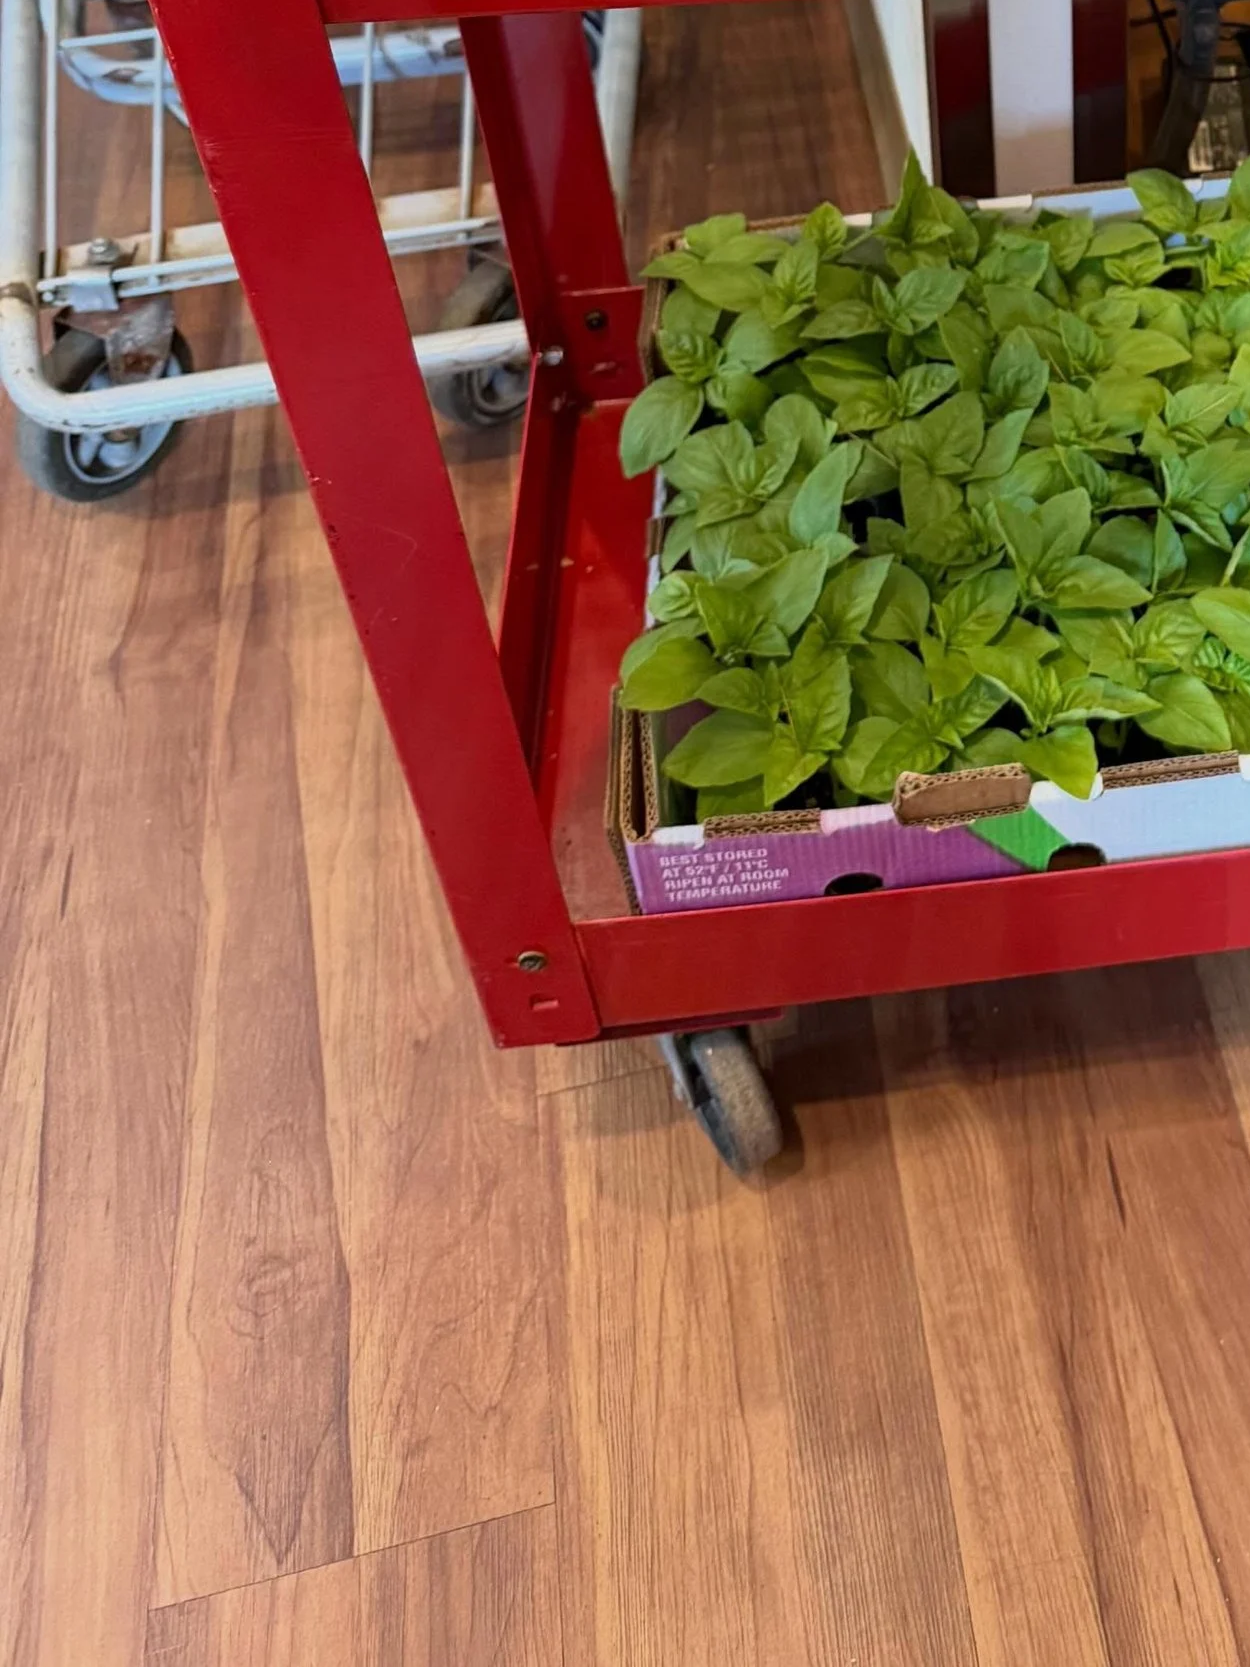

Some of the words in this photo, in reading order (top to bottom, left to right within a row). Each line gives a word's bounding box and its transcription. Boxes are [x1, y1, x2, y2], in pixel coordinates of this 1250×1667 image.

[659, 853, 700, 867] BEST
[704, 848, 768, 862] STORED
[661, 866, 681, 880] AT
[722, 861, 730, 874] /
[665, 876, 713, 890] RIPEN
[716, 872, 735, 885] AT
[740, 868, 789, 883] ROOM
[668, 881, 782, 902] TEMPERATURE
